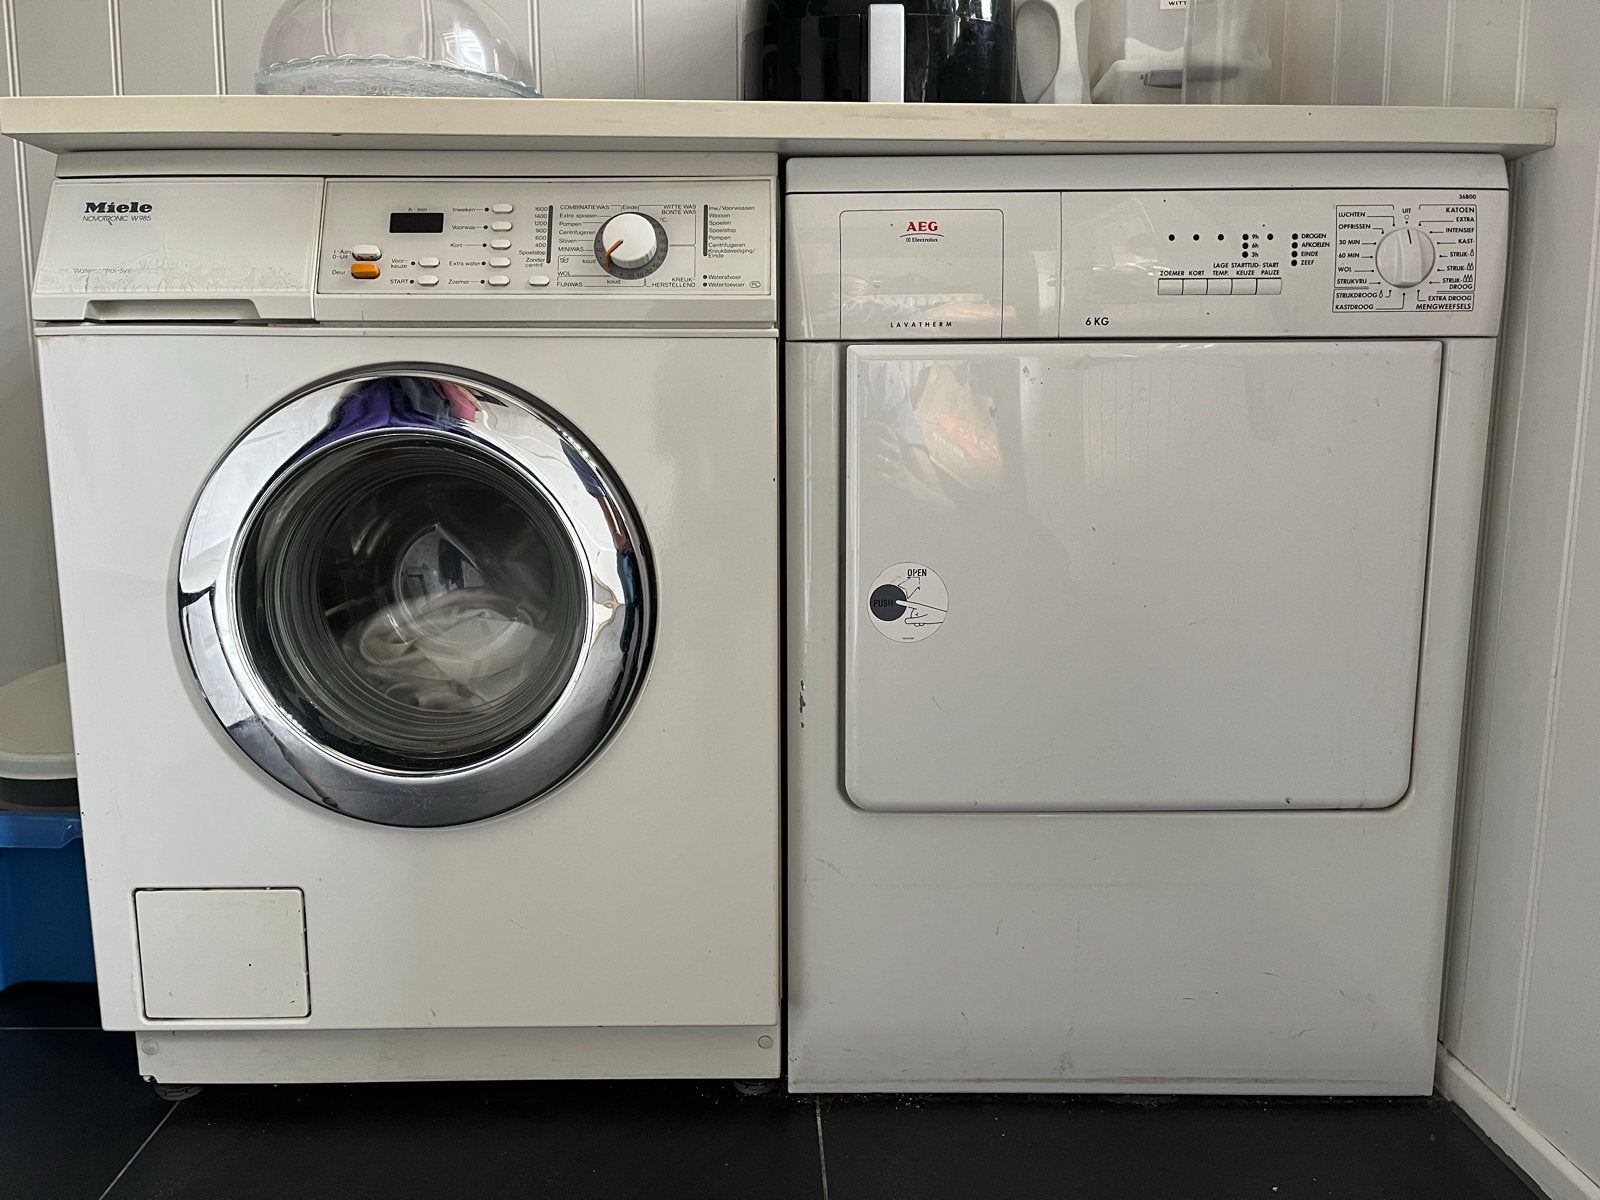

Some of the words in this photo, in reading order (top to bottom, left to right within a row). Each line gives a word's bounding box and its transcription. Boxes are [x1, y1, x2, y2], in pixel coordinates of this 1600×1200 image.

[85, 202, 152, 213] Miele
[83, 216, 128, 224] NOVOTRONIC
[907, 221, 938, 231] AEG
[1085, 317, 1092, 326] 6
[1094, 317, 1109, 326] KG
